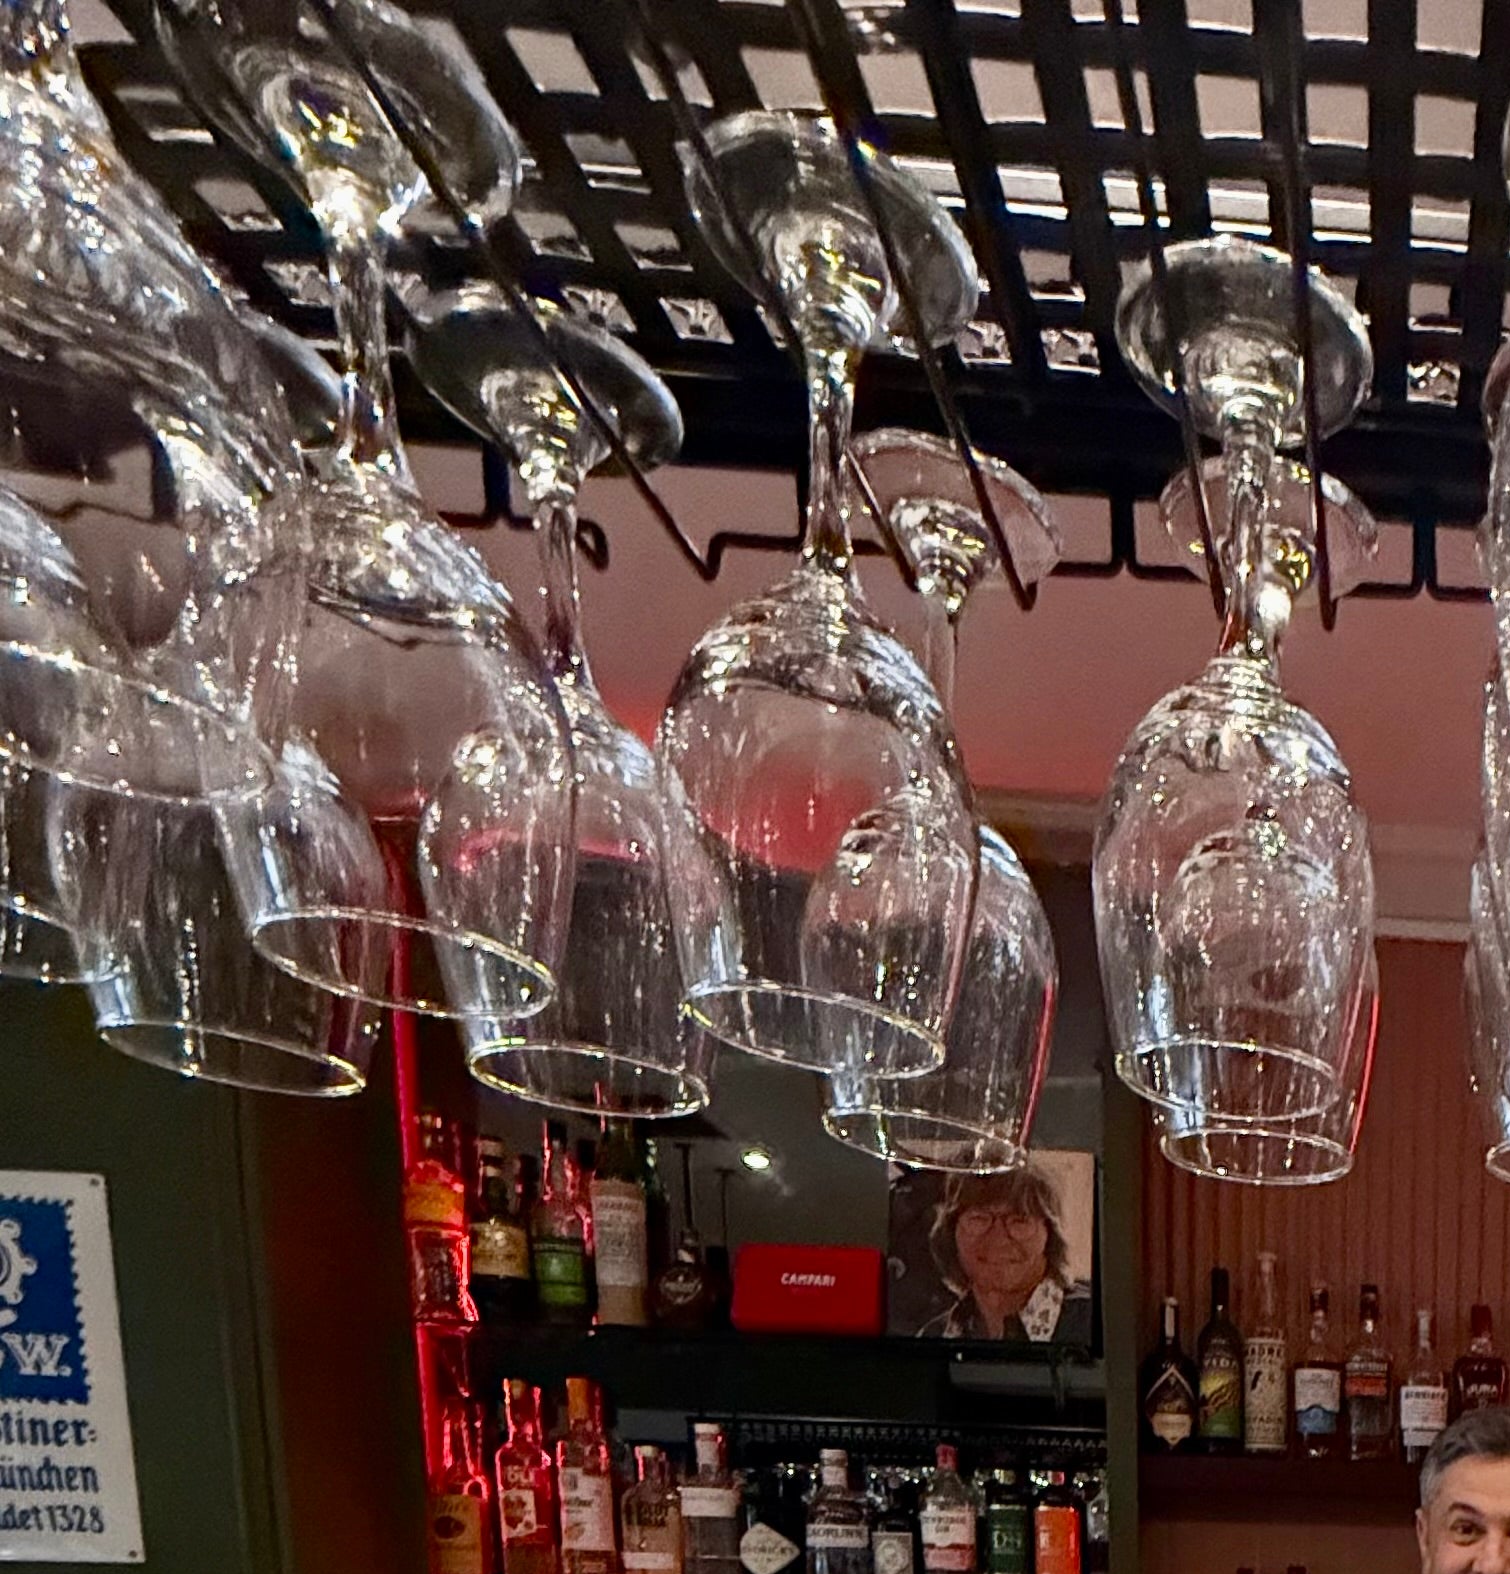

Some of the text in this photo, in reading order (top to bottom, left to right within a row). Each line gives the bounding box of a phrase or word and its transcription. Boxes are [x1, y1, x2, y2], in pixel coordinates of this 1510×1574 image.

[781, 1272, 836, 1287] CAMPARI
[0, 1455, 100, 1493] ünchen
[46, 1504, 104, 1534] 1328
